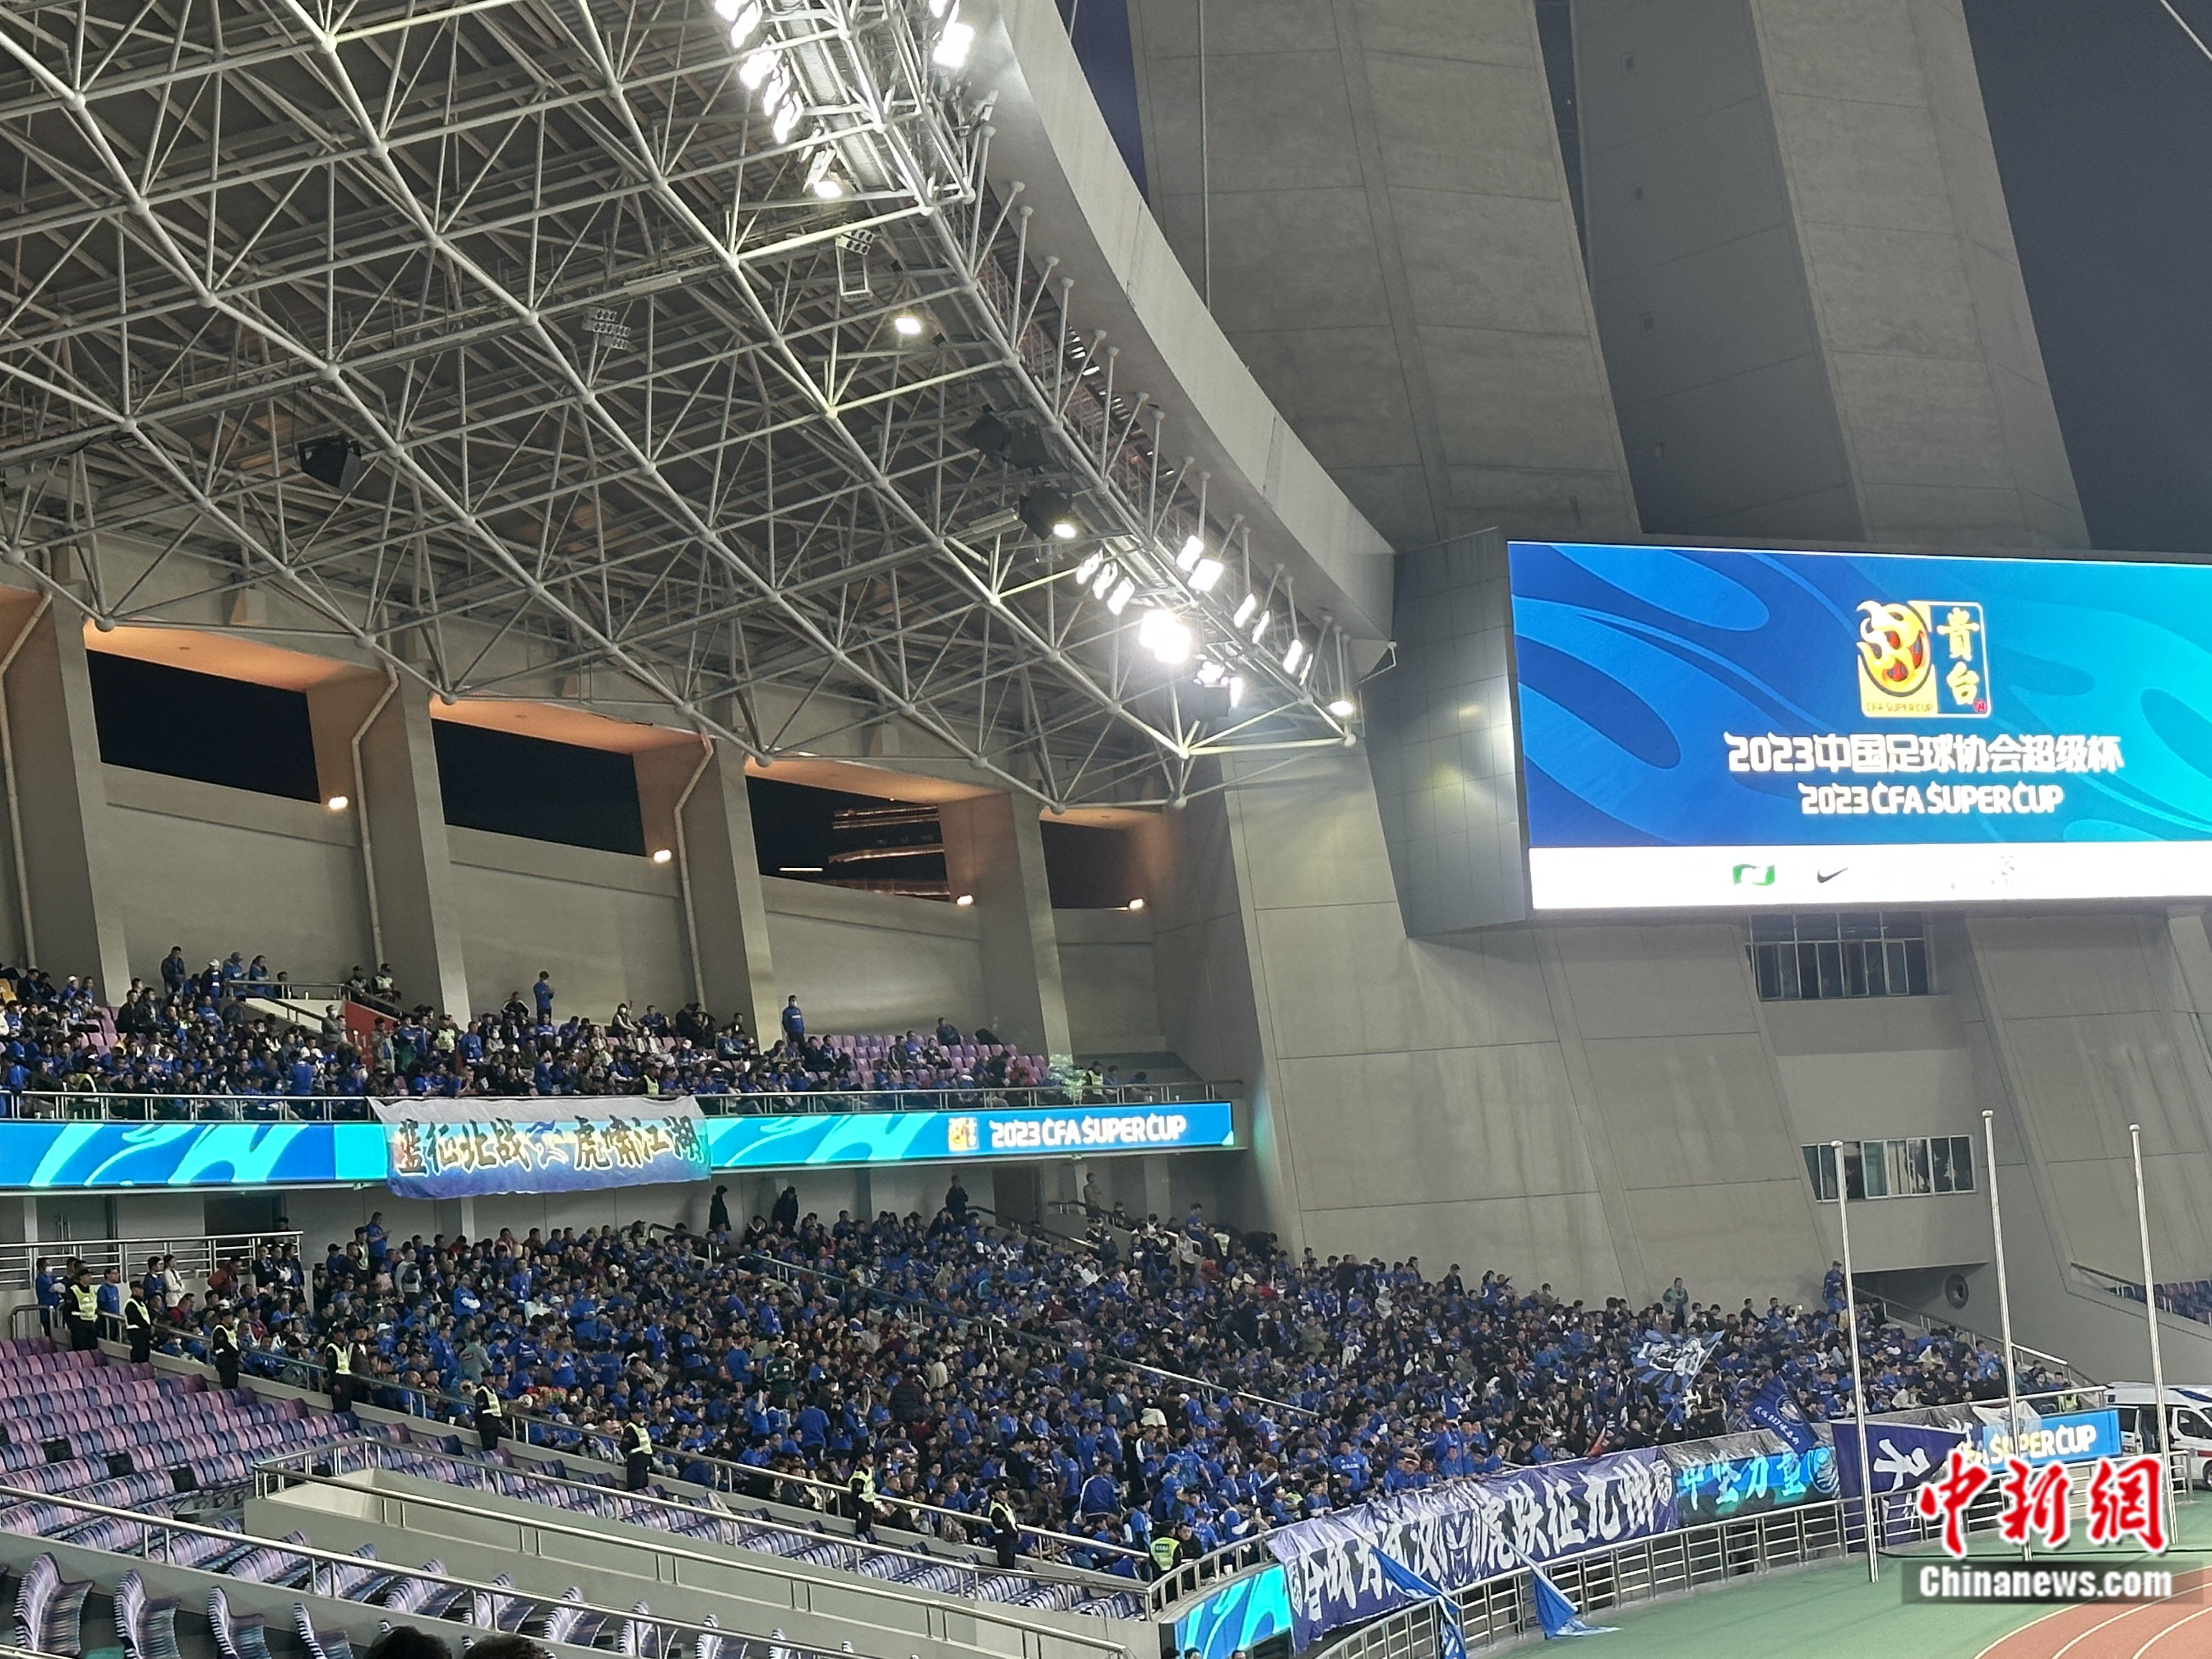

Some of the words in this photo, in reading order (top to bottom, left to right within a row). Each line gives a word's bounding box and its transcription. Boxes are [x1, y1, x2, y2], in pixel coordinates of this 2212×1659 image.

[1866, 702, 1883, 712] CFA
[1886, 702, 1914, 712] SUPER
[1916, 702, 1933, 712] CUP
[1723, 731, 2125, 773] 2023中国足球协会超级杯
[1797, 782, 1869, 814] 2023
[1871, 781, 1925, 814] CFA
[1926, 781, 2012, 814] SUPER
[2012, 781, 2064, 813] CUP
[989, 1119, 1041, 1148] 2023
[1042, 1117, 1079, 1146] CFA
[1082, 1115, 1147, 1145] SUPER
[1147, 1113, 1186, 1141] CUP
[2056, 1424, 2097, 1454] CUP
